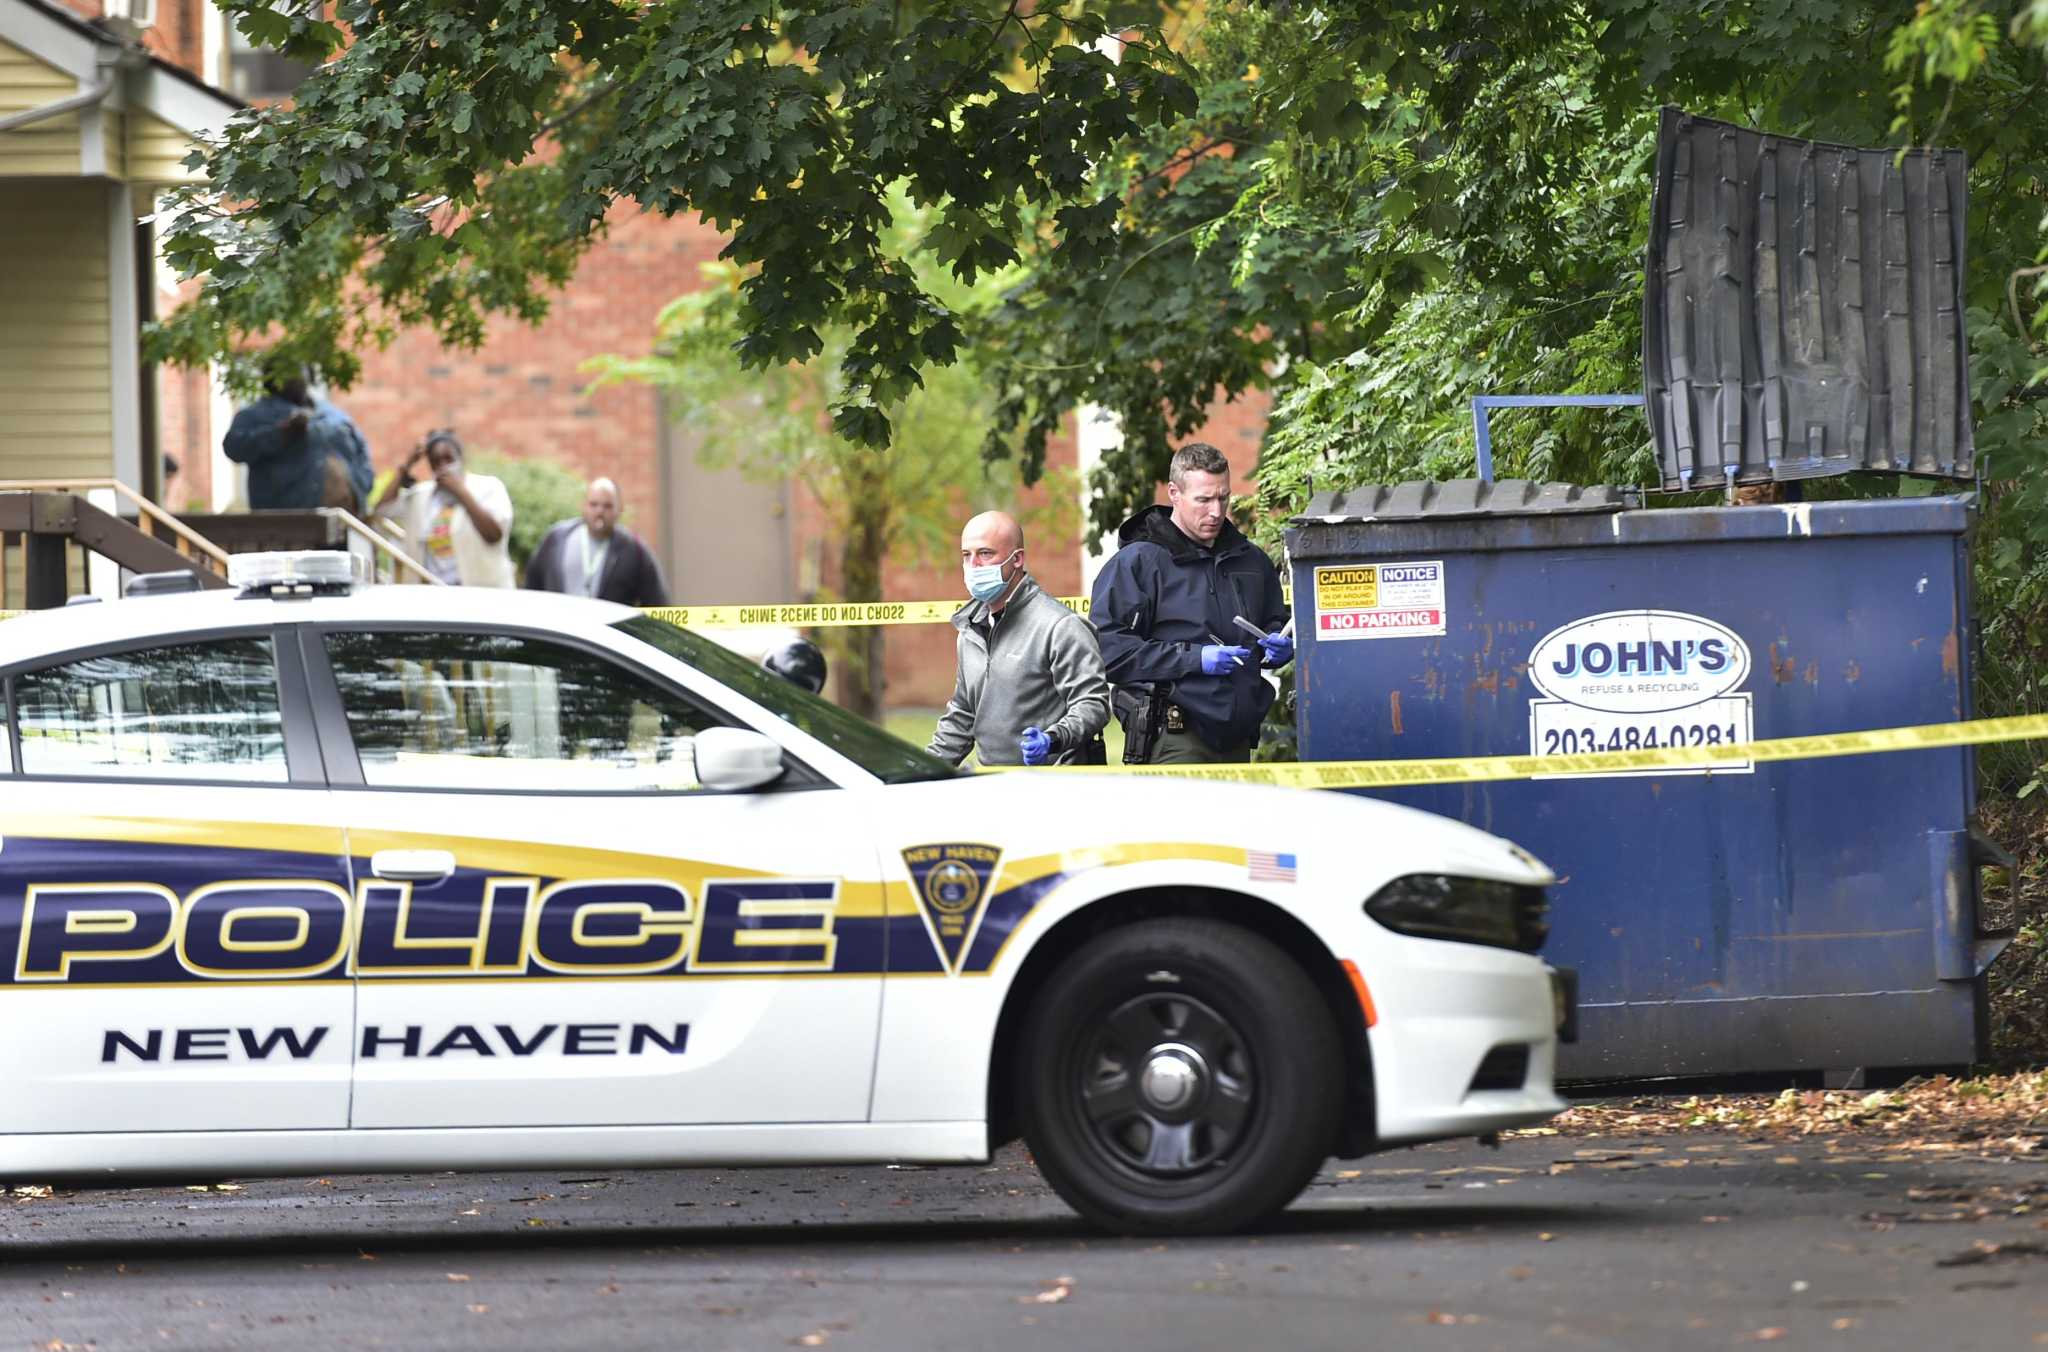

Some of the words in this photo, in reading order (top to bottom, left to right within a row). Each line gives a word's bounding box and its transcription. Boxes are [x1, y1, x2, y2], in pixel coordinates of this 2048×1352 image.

[1320, 571, 1373, 584] CAUTION
[1383, 567, 1436, 581] NOTICE
[1329, 615, 1355, 629] NO
[1358, 611, 1431, 628] PARKING
[1552, 639, 1729, 676] JOHN'S
[1581, 684, 1623, 694] REFUSE
[1628, 685, 1635, 693] &
[1638, 682, 1700, 693] RECYCLING
[1545, 724, 1736, 755] 203-484-0281
[14, 877, 841, 981] POLICE
[102, 1027, 329, 1062] NEW
[360, 1023, 690, 1058] HAVEN
